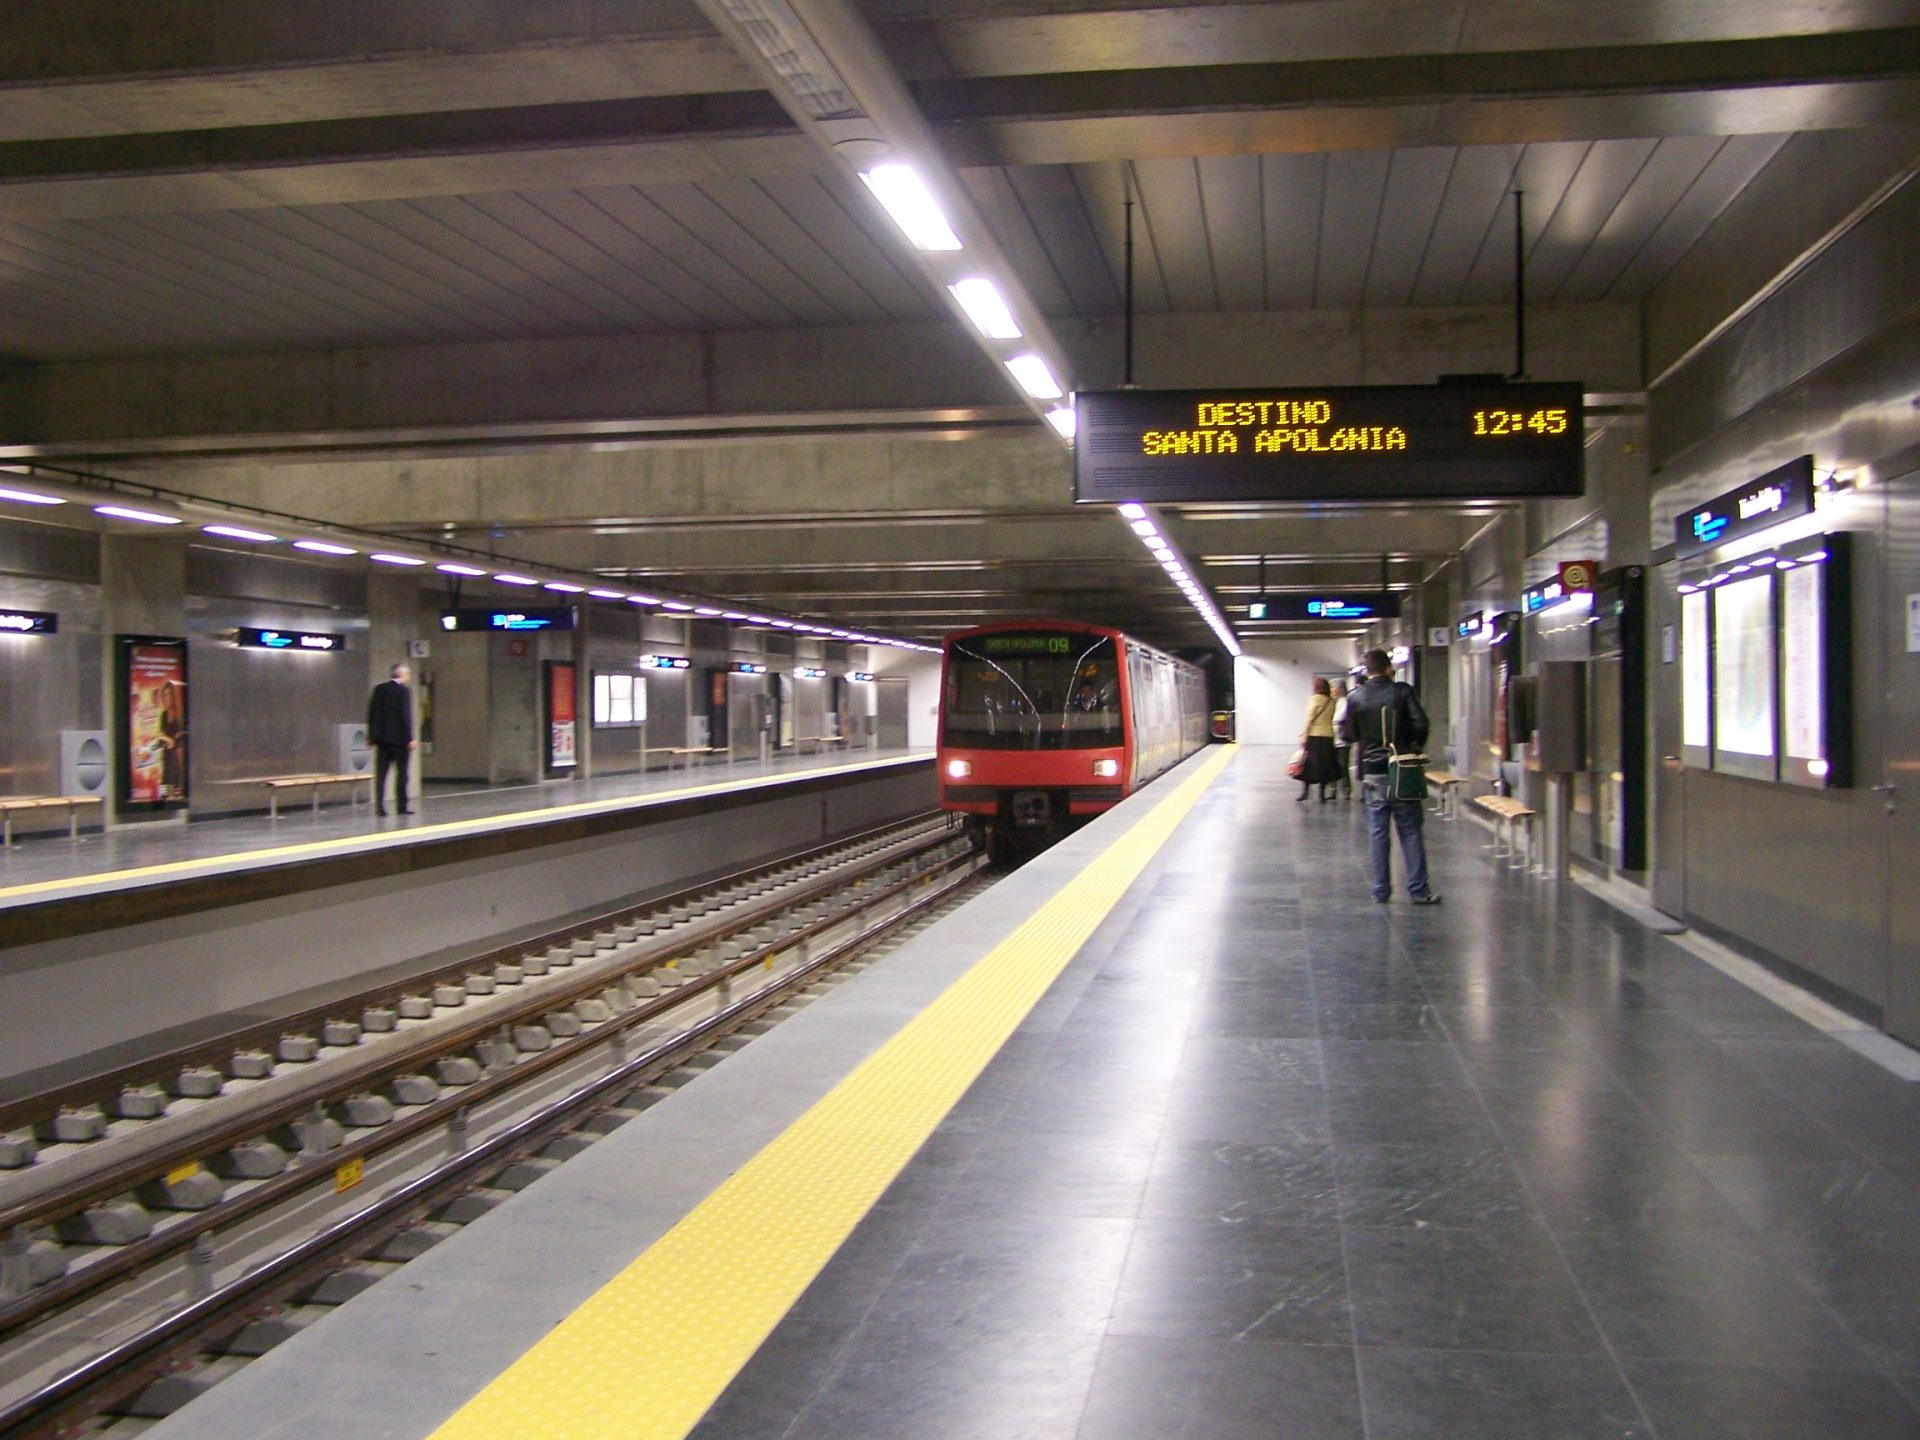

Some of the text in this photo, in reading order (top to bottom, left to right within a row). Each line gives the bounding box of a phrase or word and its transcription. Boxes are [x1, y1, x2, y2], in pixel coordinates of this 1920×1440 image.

[1198, 401, 1331, 427] DESTINO
[1473, 410, 1567, 435] 12:45
[1143, 430, 1238, 455] SANTA
[1048, 638, 1069, 652] 09
